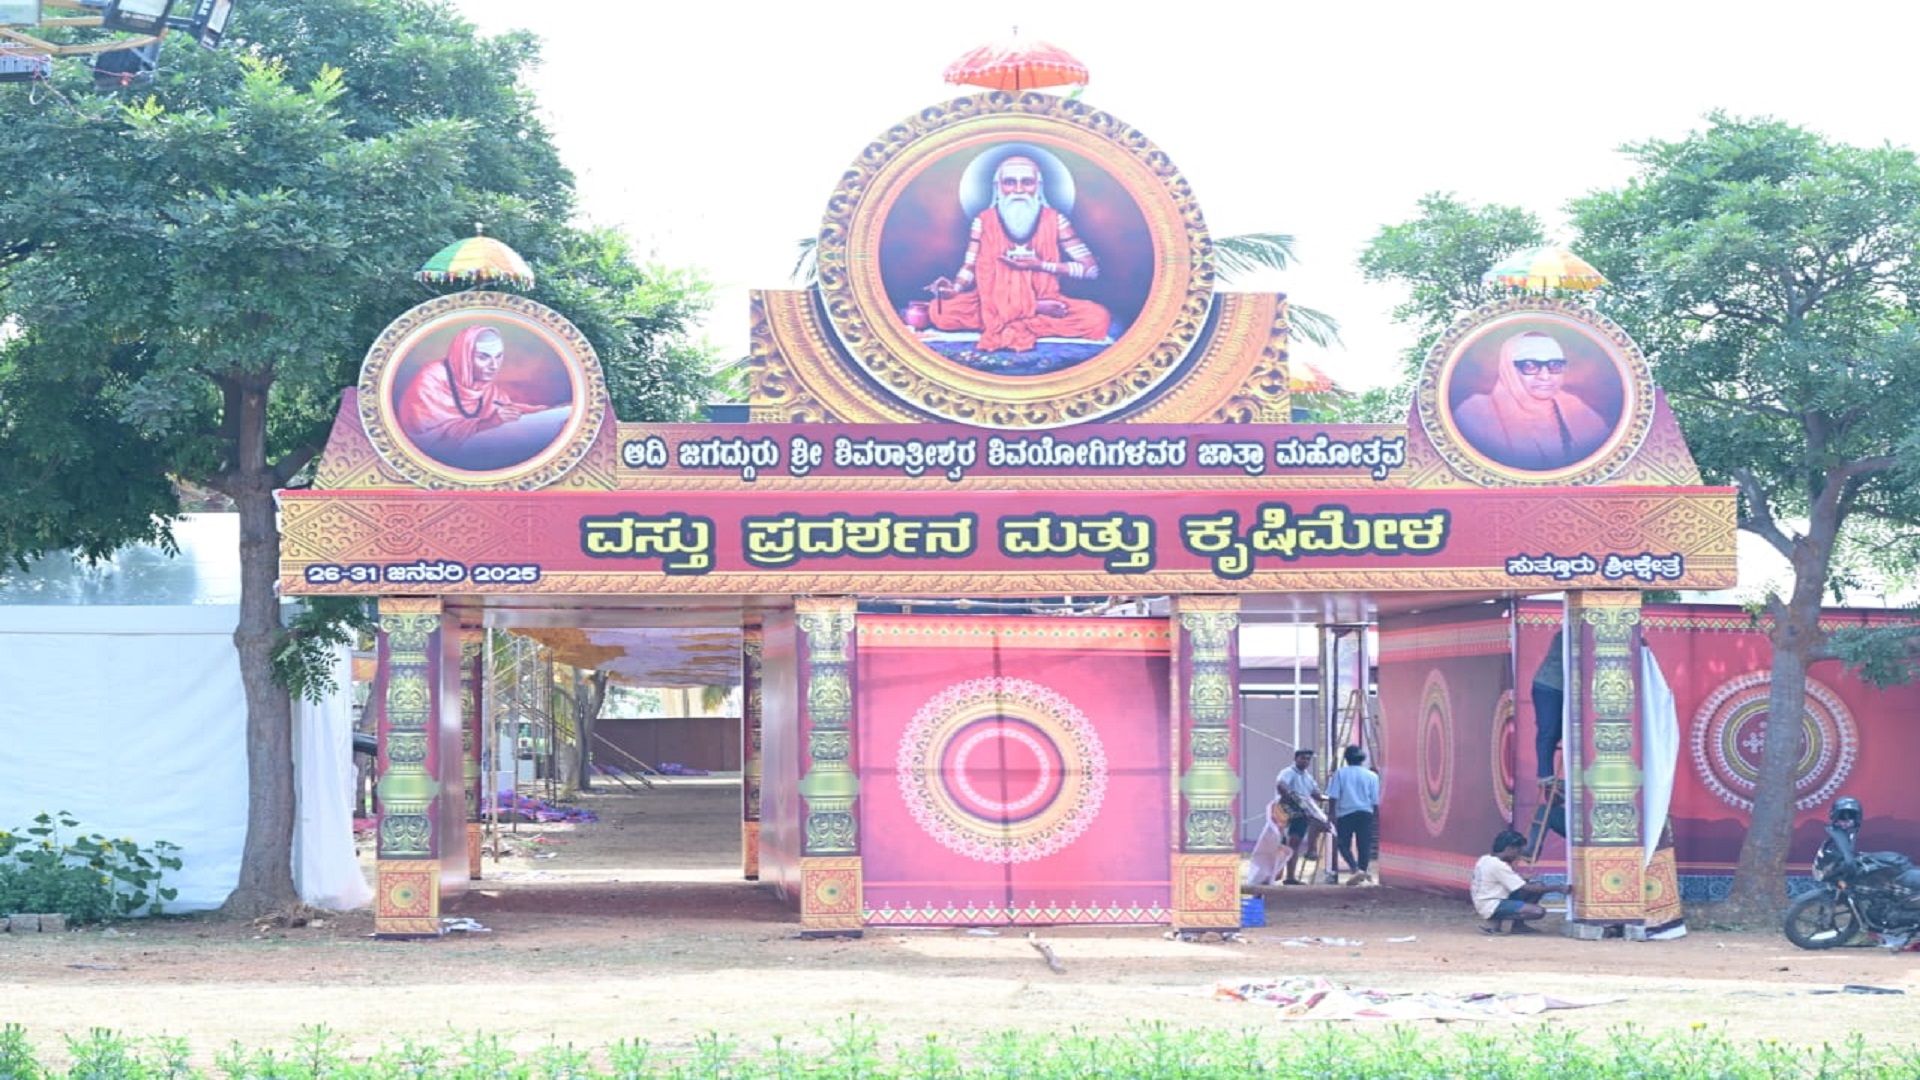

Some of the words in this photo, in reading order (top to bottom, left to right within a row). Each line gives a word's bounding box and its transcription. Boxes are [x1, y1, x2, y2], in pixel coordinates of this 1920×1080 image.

[624, 440, 667, 466] ಆದಿ
[680, 440, 778, 479] ಜಗದ್ಗುರು
[791, 438, 822, 474] ಶ್ರೀ
[988, 436, 1186, 466] ಶಿವಯೋಗಿಗಳವರ
[1198, 442, 1265, 473] ಜಾತ್ರಾ
[1276, 436, 1404, 477] ಮಹೋತ್ಸವ
[586, 517, 709, 569] ವಸ್ತು
[748, 517, 972, 564] ಪ್ರದರ್ಶನ
[1003, 516, 1151, 568] ಮತ್ತು
[1185, 508, 1445, 574] ಕೃಷಿಮೇಳ
[307, 565, 378, 581] 26-31
[386, 561, 464, 581] ಜನವರಿ
[473, 565, 538, 581] 2025
[1507, 555, 1597, 578] ಸುತ್ತೂರು
[1603, 554, 1681, 579] ಶ್ರೀಕ್ಷೇತ್ರ
